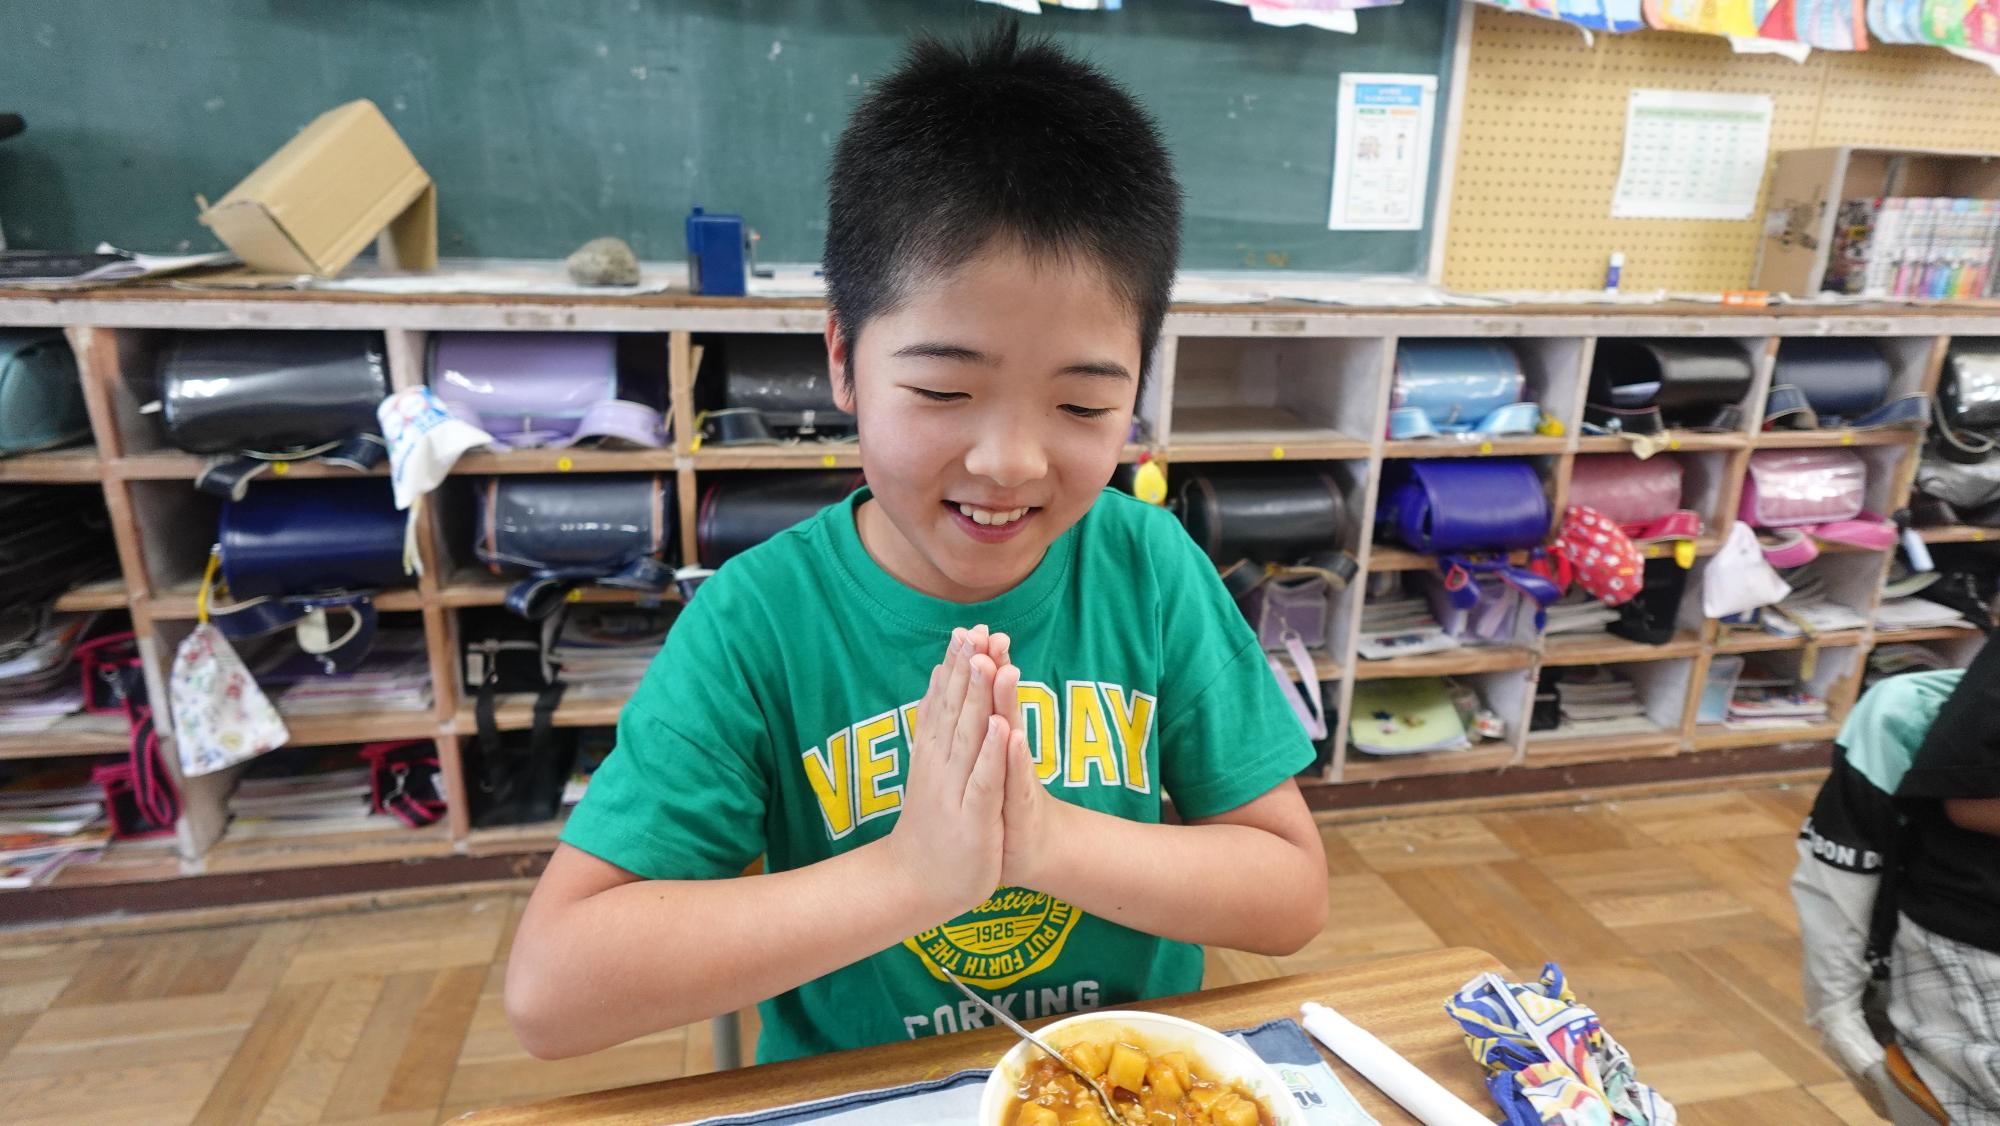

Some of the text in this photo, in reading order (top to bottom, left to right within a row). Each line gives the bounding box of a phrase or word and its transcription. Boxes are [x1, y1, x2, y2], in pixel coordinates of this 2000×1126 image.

[802, 680, 1157, 841] VEDAY
[972, 890, 1049, 914] estige
[927, 899, 1072, 977] OU PUT FORTH THE
[974, 921, 1015, 943] 1926
